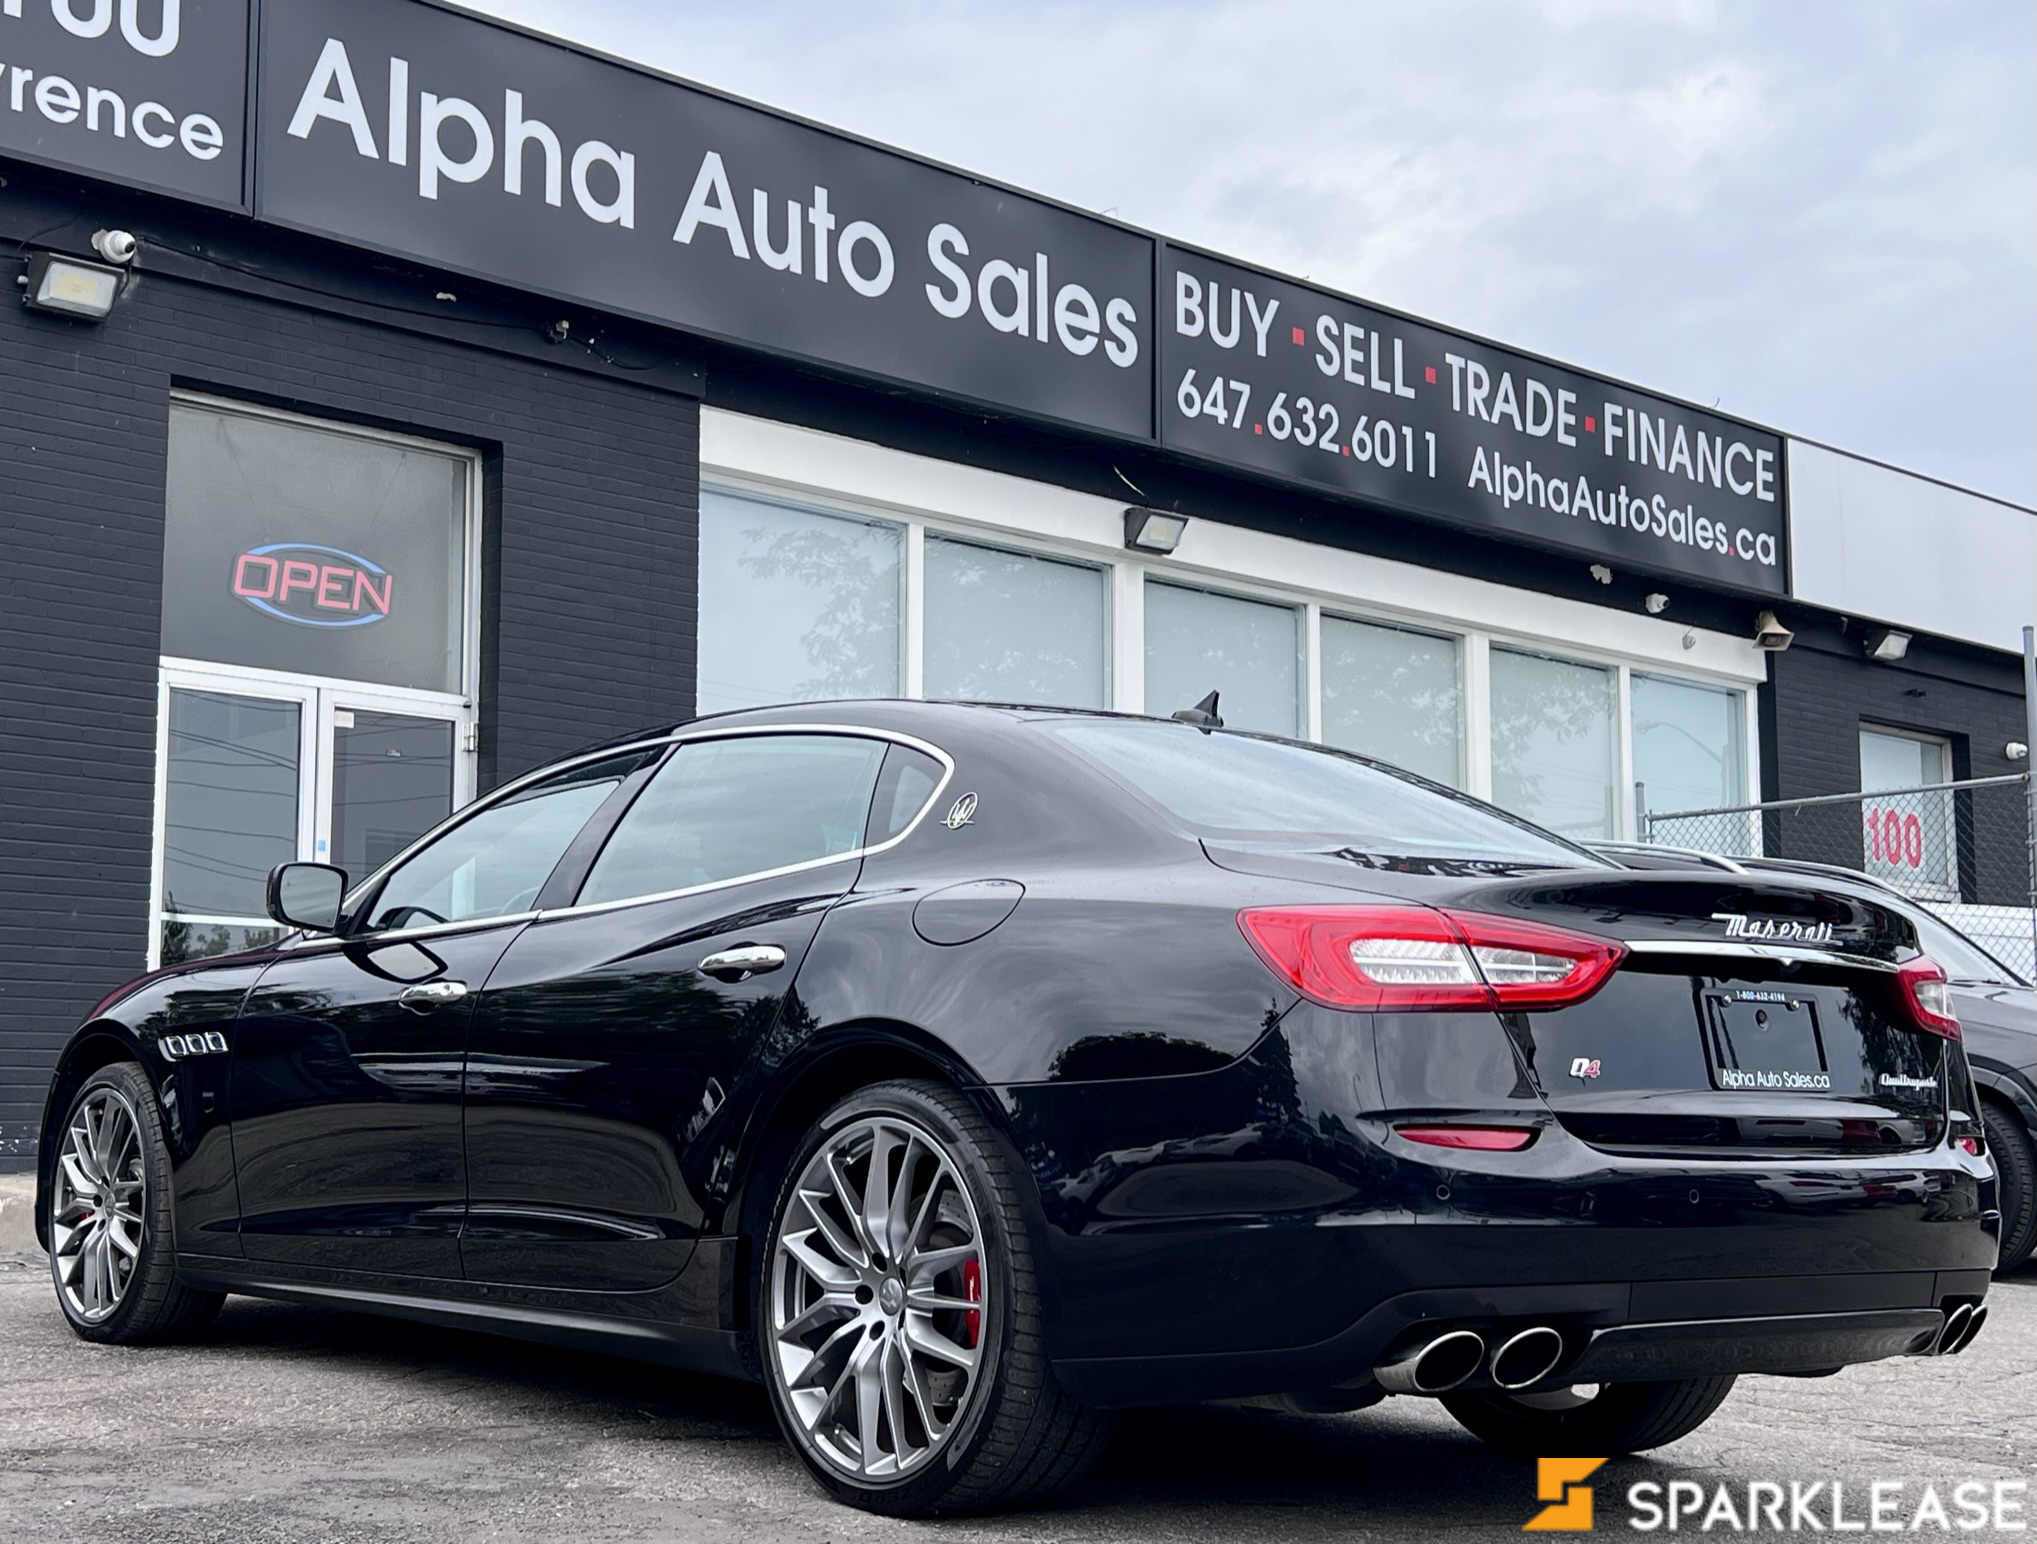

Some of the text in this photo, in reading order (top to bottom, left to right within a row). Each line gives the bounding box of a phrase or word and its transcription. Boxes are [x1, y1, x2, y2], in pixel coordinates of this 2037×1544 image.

[0, 62, 223, 160] rence
[287, 38, 1138, 368] Alpha Auto Sales
[1175, 271, 1774, 502] BUY SELL TRADE FINANCE
[1177, 368, 1437, 478] 647.632.6011
[1468, 446, 1775, 566] AlphaAutoSales.ca
[233, 552, 392, 616] OPEN
[1867, 807, 1921, 869] 100
[1711, 912, 1843, 946] Maserati
[1570, 1057, 1601, 1079] Q4
[1723, 1069, 1831, 1089] Alpha Auto Sales.ca
